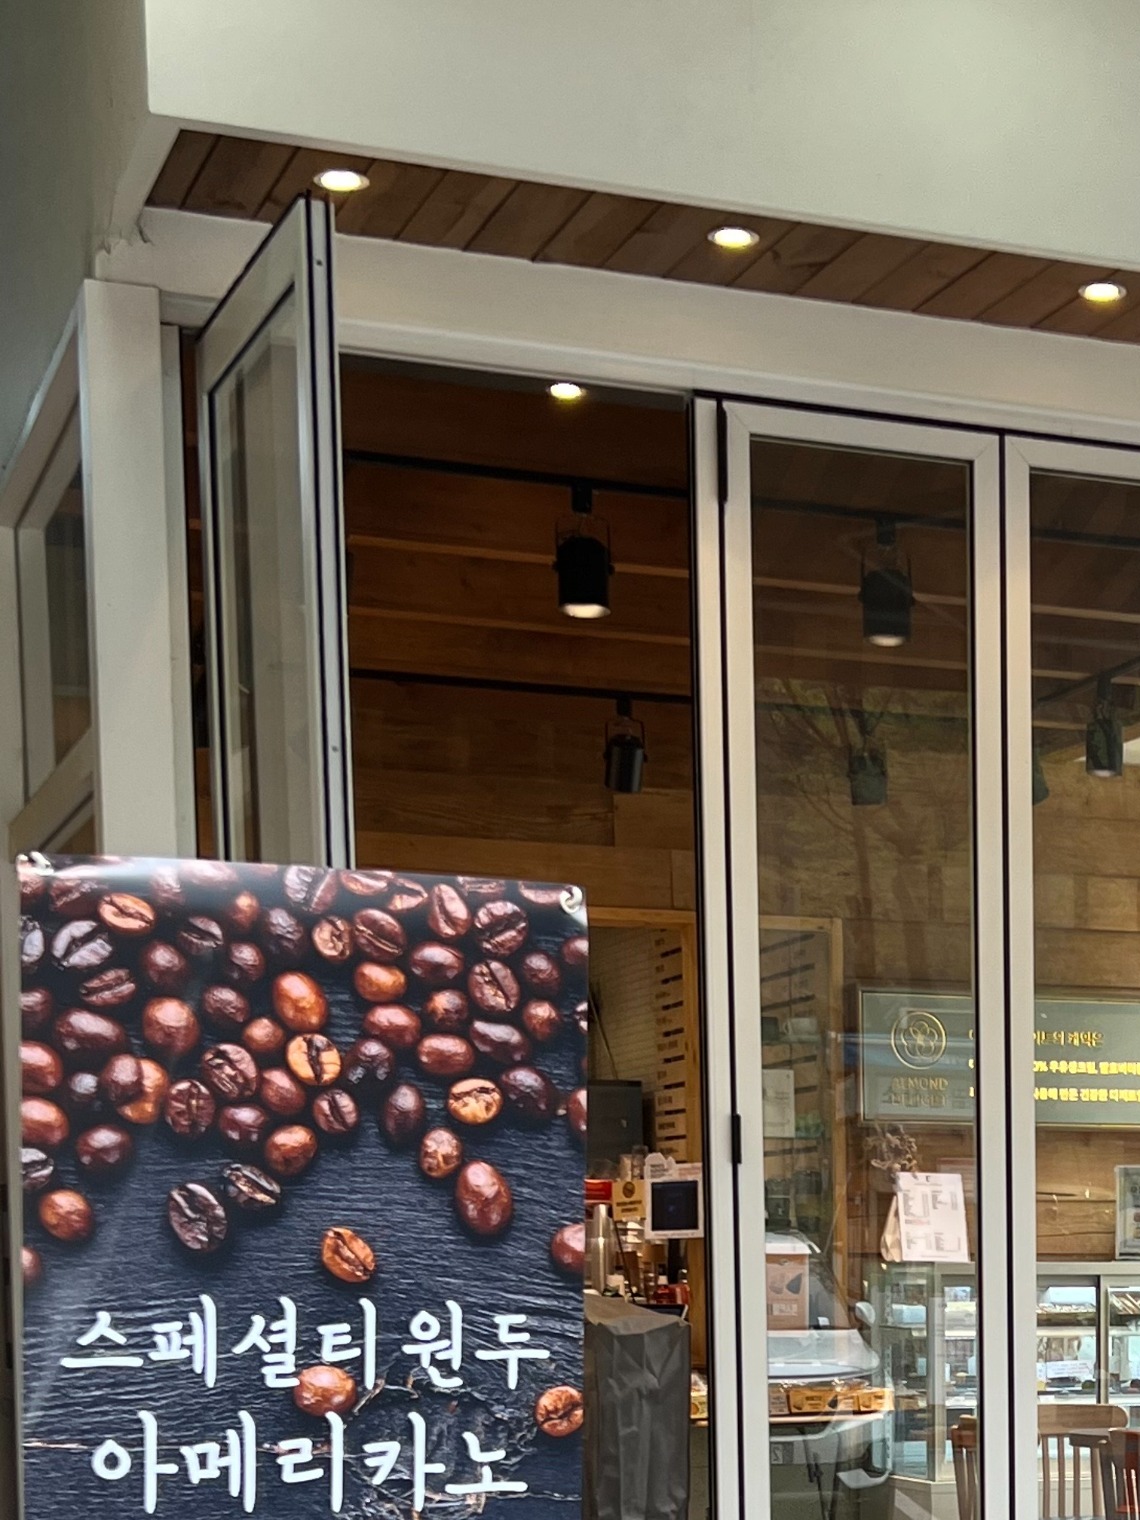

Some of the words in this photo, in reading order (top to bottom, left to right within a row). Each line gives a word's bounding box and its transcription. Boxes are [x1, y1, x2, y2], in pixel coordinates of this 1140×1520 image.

[60, 1294, 376, 1390] 스페셜티
[402, 1300, 550, 1390] 원두
[91, 1410, 528, 1514] 아메리카노
